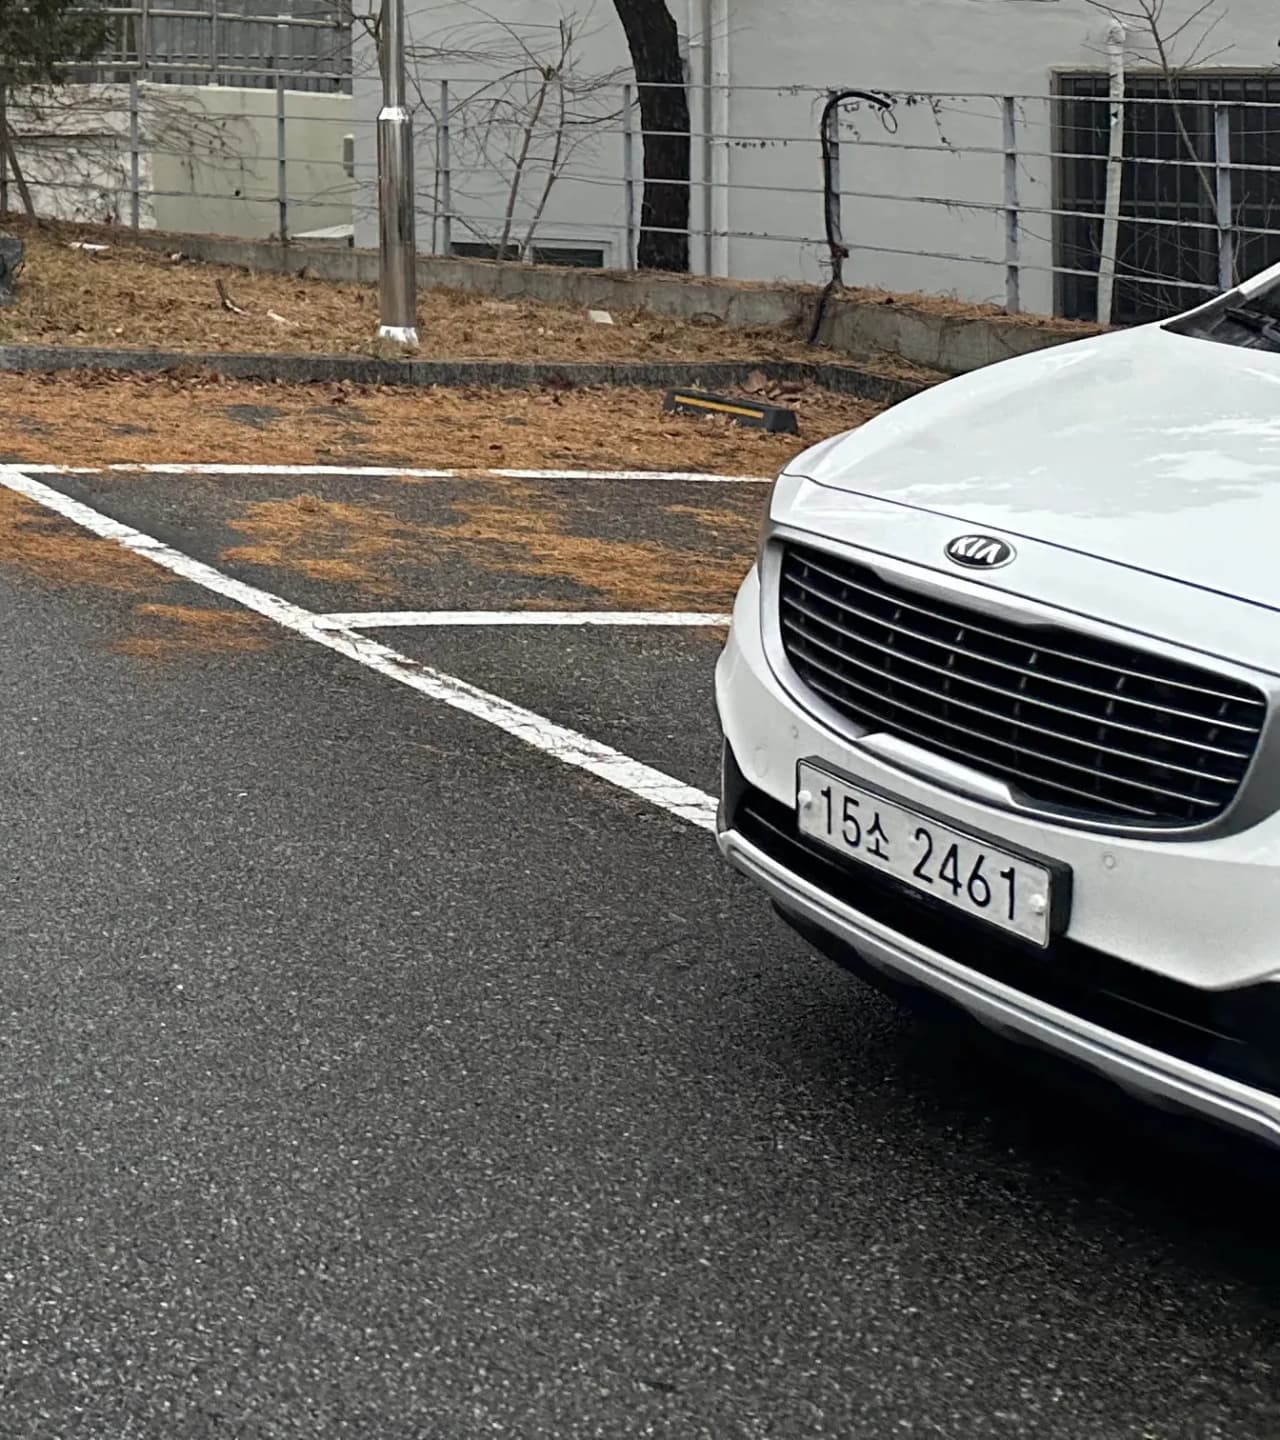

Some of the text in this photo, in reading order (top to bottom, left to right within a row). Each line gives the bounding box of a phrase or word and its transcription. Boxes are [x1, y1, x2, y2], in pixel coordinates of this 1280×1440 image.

[950, 537, 1001, 565] KIA
[820, 786, 1017, 921] 15소 2461
